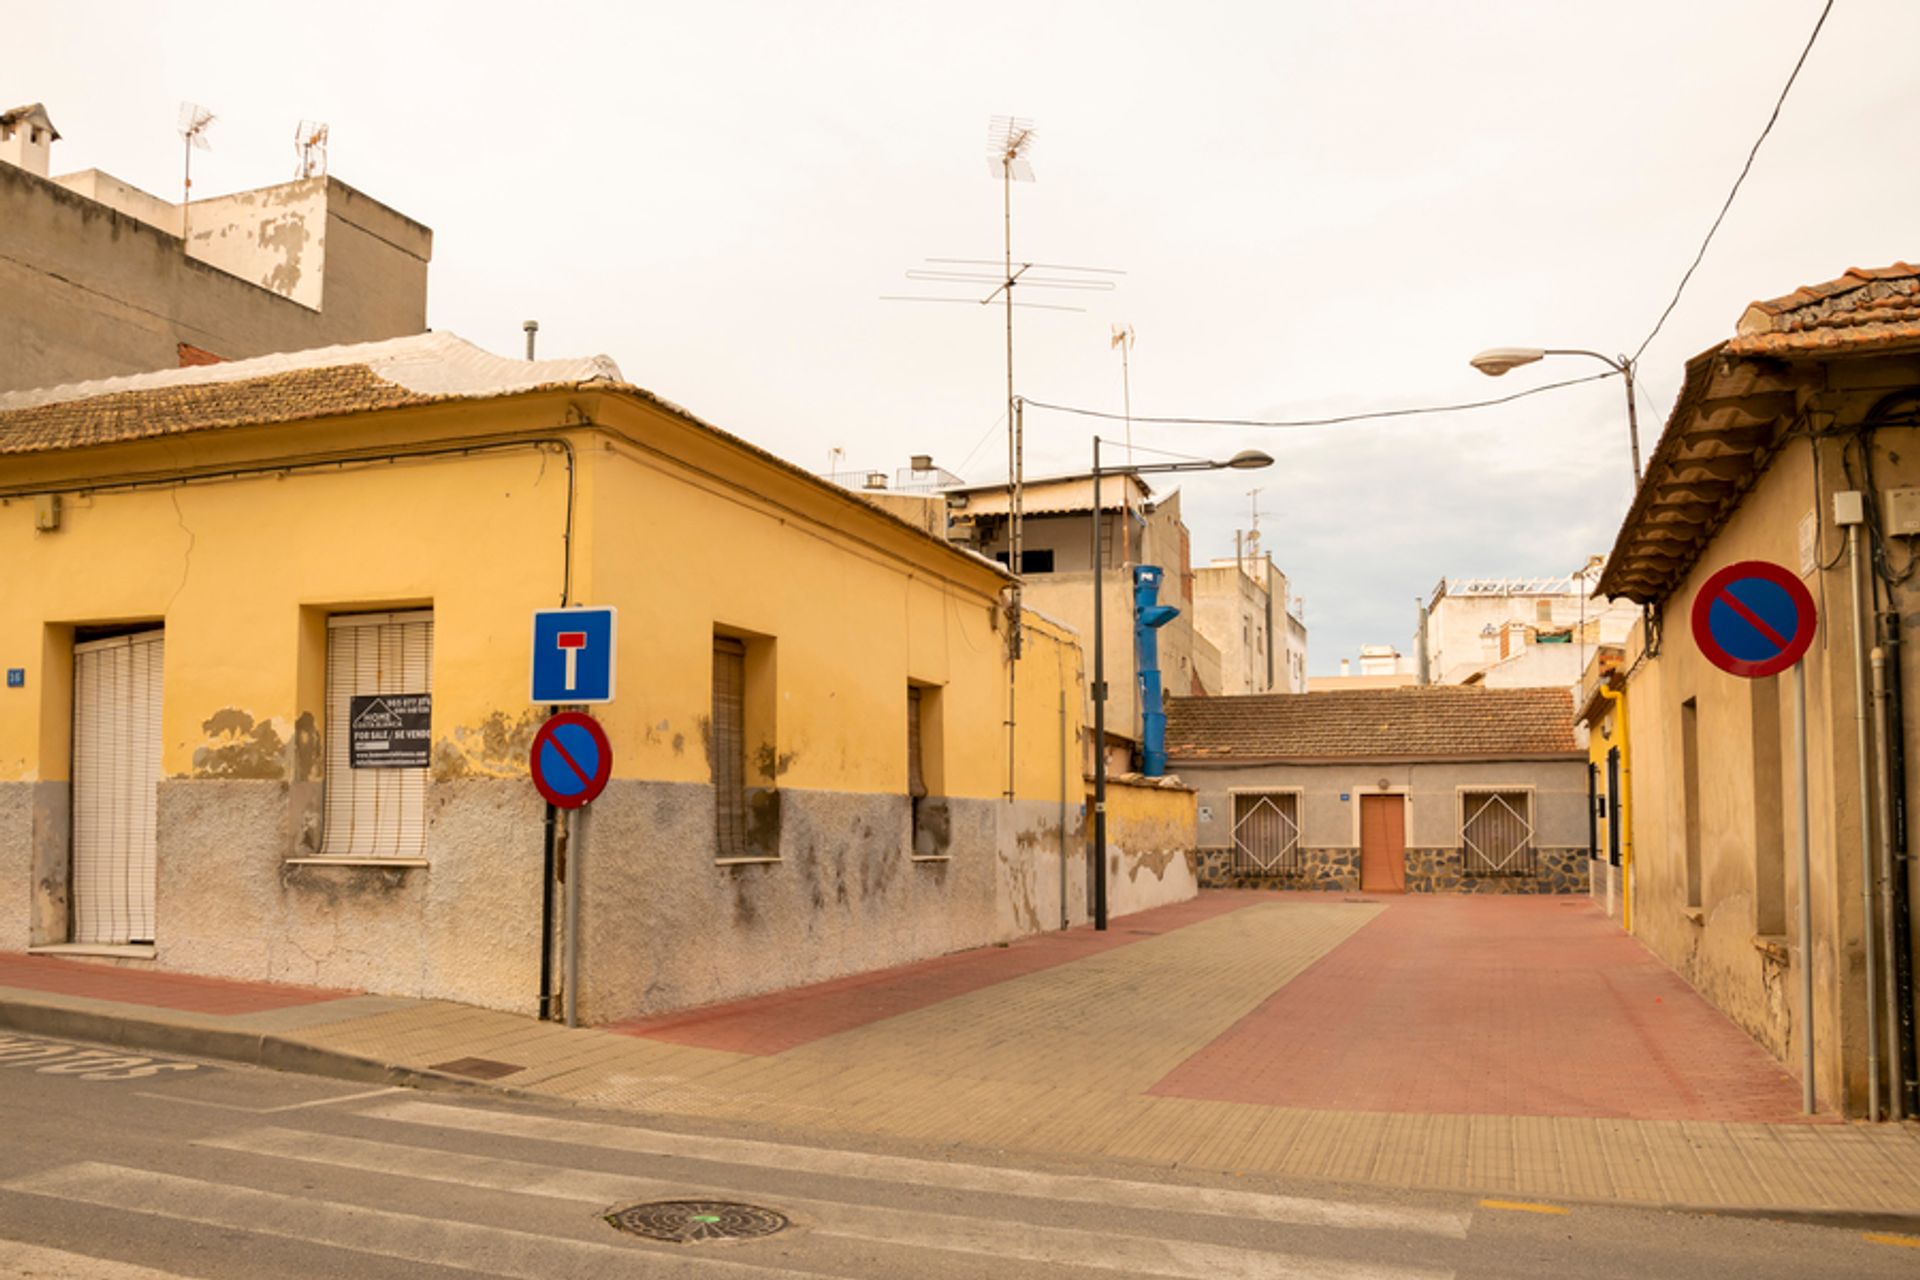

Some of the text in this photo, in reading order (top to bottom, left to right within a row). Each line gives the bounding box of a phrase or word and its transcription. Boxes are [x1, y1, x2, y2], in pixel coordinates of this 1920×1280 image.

[354, 731, 370, 740] FOR
[371, 730, 388, 739] SALE
[394, 730, 405, 739] SE
